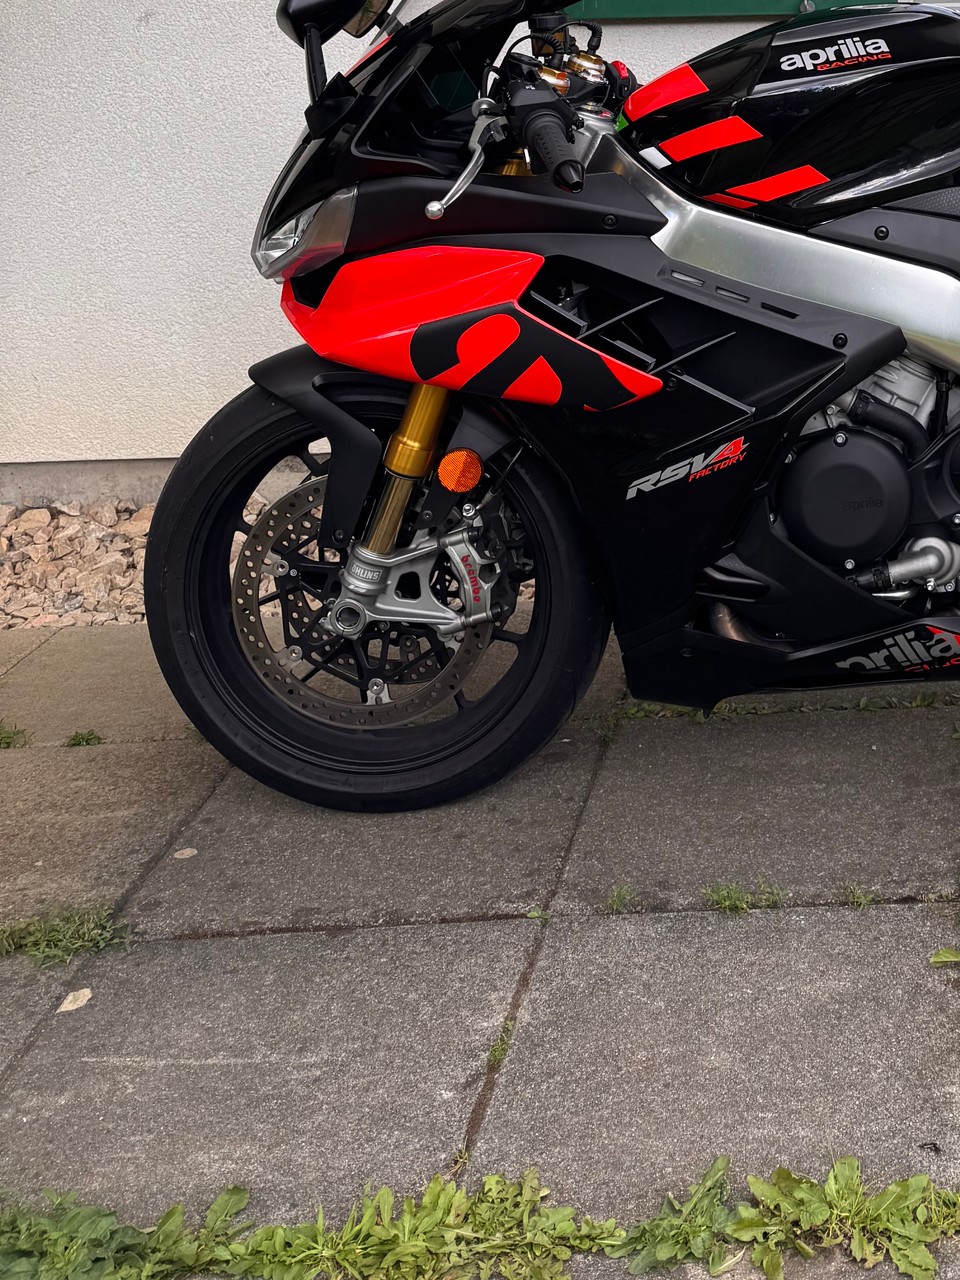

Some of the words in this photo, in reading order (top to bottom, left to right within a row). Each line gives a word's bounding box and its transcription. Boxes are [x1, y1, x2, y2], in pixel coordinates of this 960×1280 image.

[779, 37, 890, 71] aprilia
[816, 52, 892, 71] RACING
[625, 436, 750, 500] RSV4
[688, 451, 747, 483] FACTORY
[845, 497, 884, 512] aprilia
[461, 555, 481, 604] brembo
